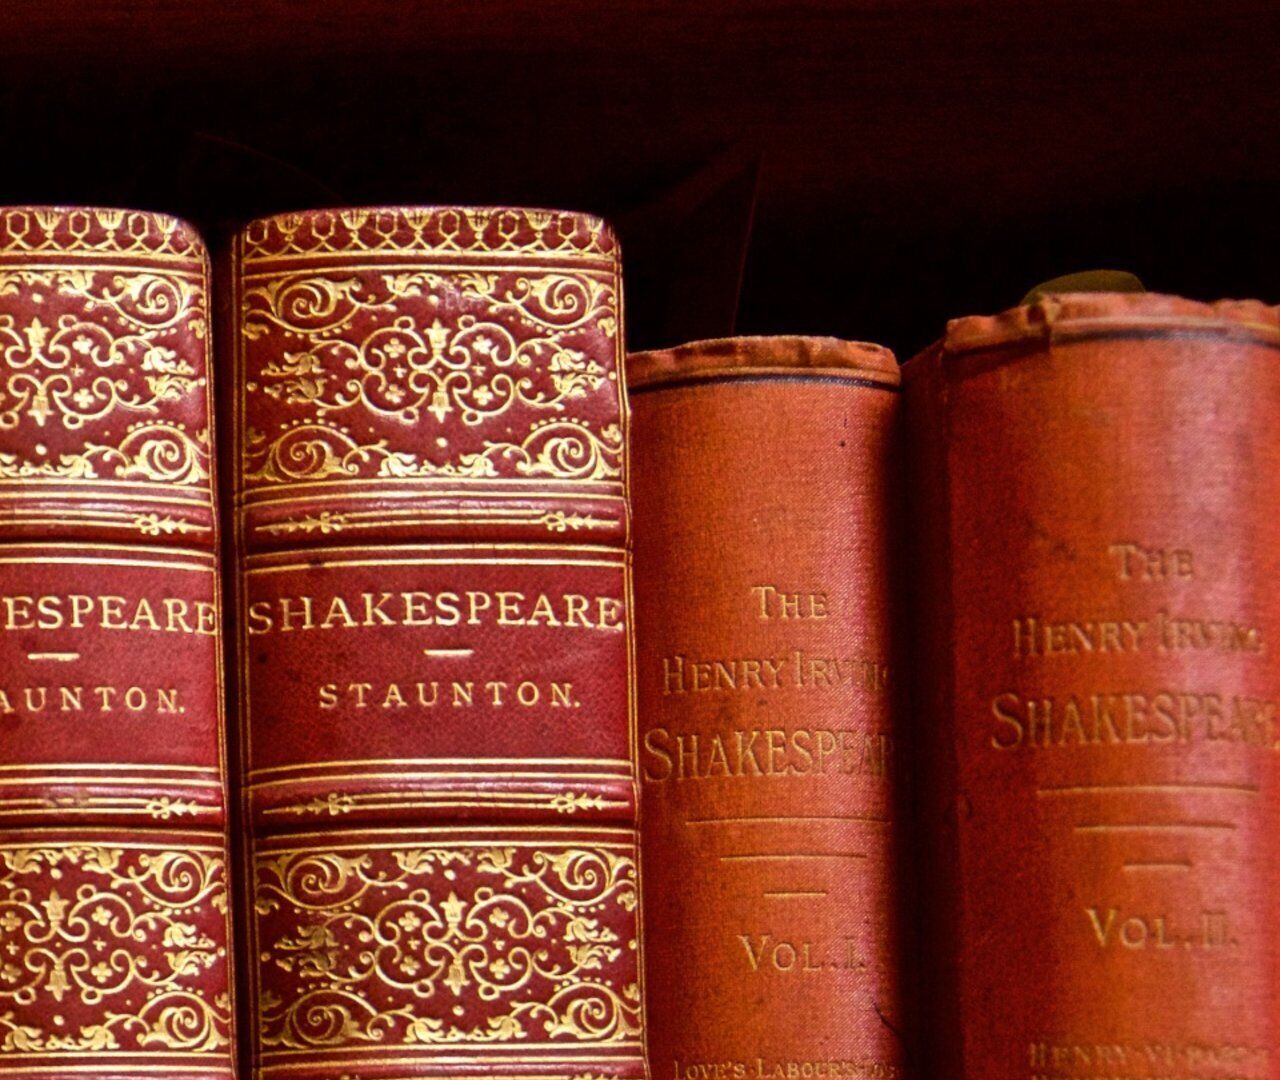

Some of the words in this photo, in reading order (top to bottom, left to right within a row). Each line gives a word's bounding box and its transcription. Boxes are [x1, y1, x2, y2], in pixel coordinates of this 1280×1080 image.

[248, 591, 624, 635] SHAKESPEARE
[1012, 616, 1150, 660] HENRY
[318, 680, 581, 709] STAUNTON.
[662, 655, 786, 696] HENRY
